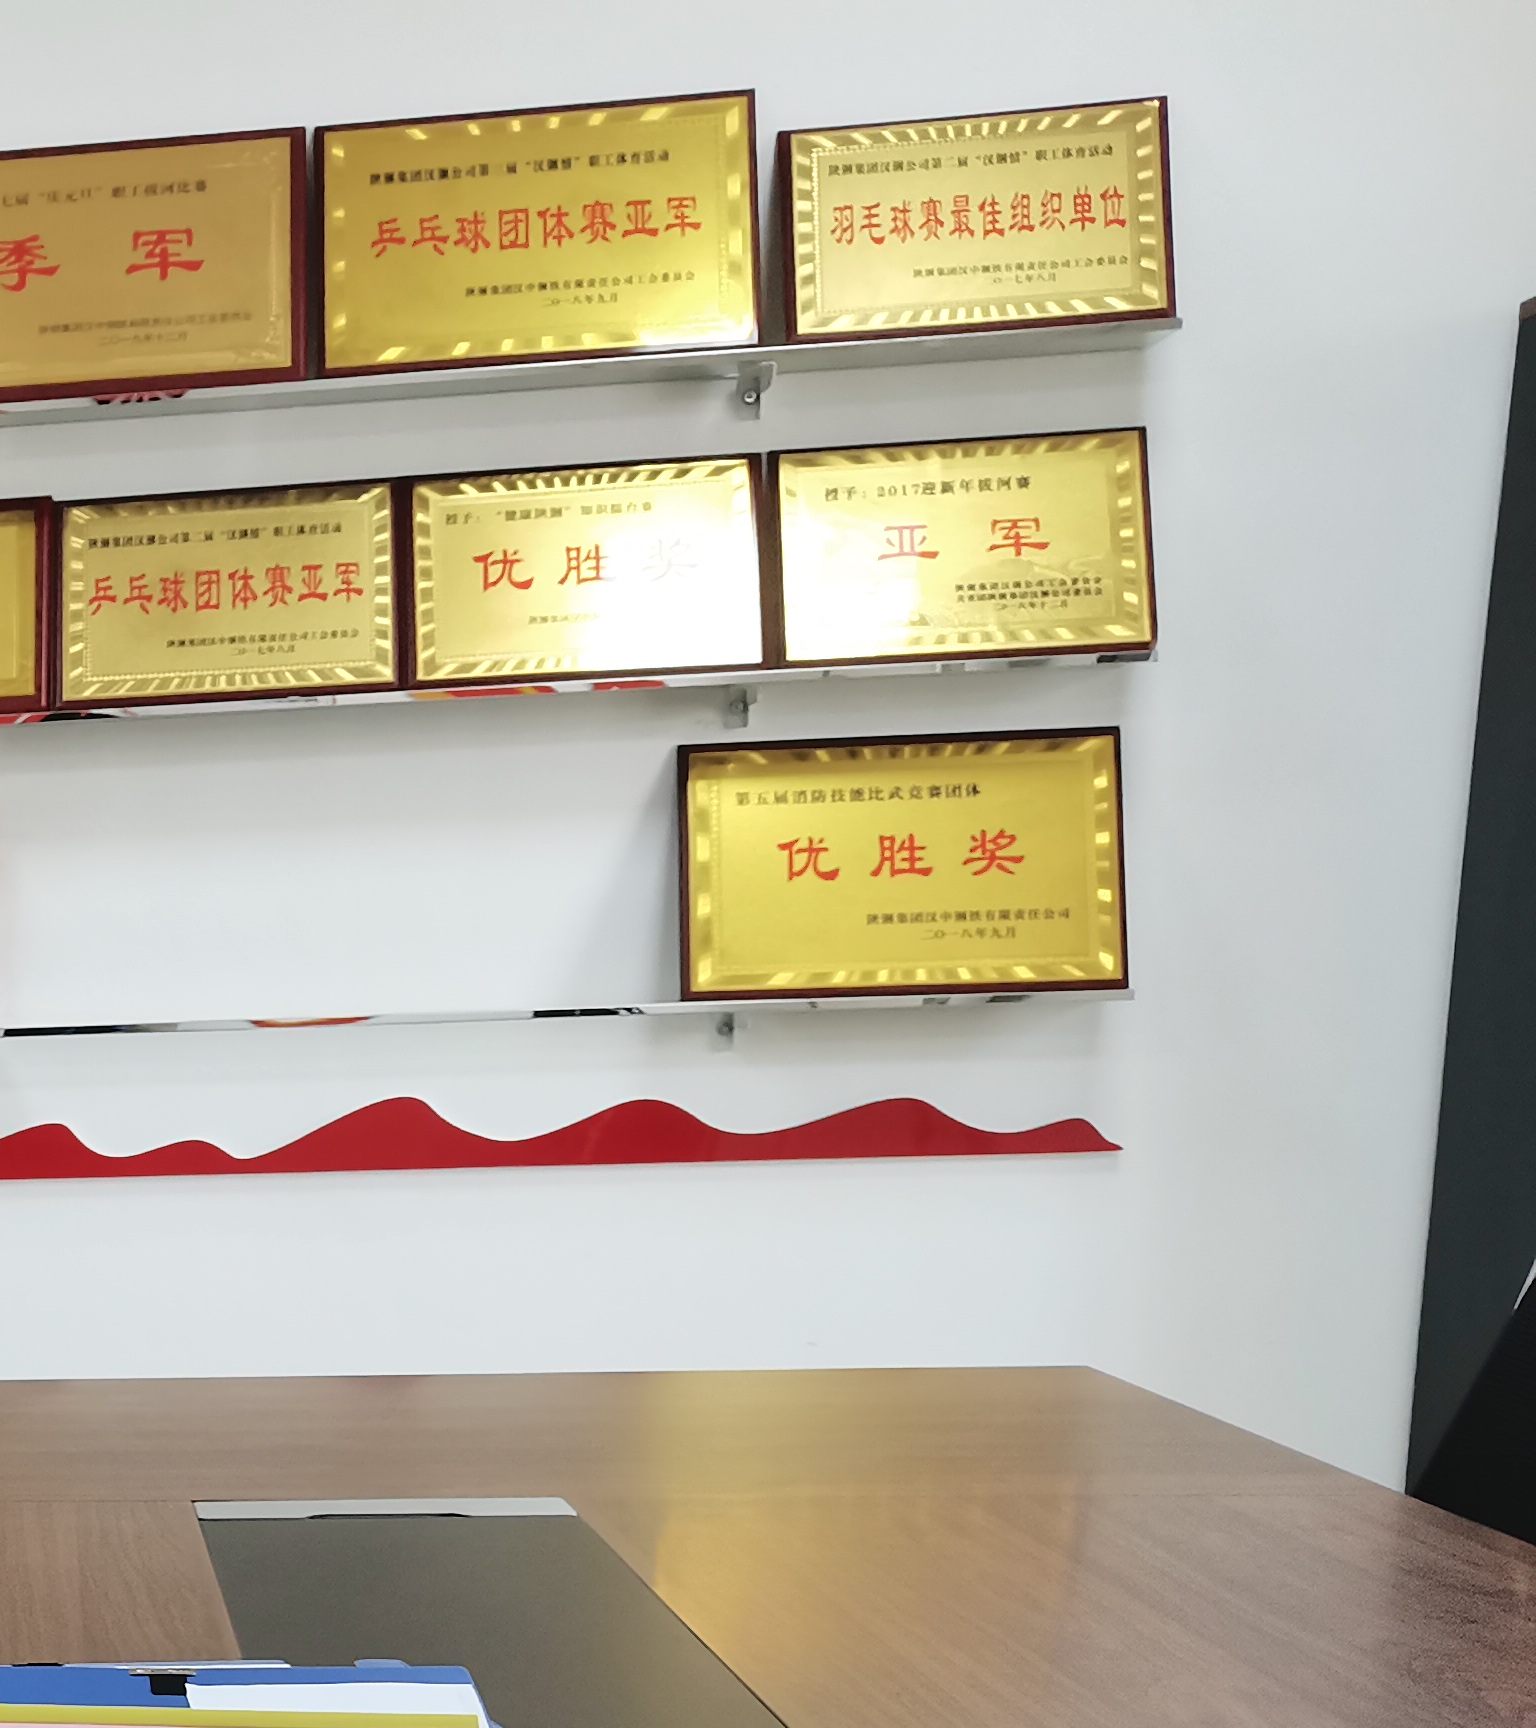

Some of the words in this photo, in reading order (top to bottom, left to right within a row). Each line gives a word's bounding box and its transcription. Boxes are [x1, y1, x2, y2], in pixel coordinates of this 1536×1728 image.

[370, 196, 703, 259] 乒乓球团体赛亚军
[830, 184, 1128, 246] 羽毛球赛最佳组织单位
[876, 516, 1052, 562] 亚军
[87, 562, 365, 617] 乒乓球团体赛亚军
[735, 782, 982, 807] 第五届消防技能比武竞赛团体
[776, 828, 1026, 883] 优胜奖
